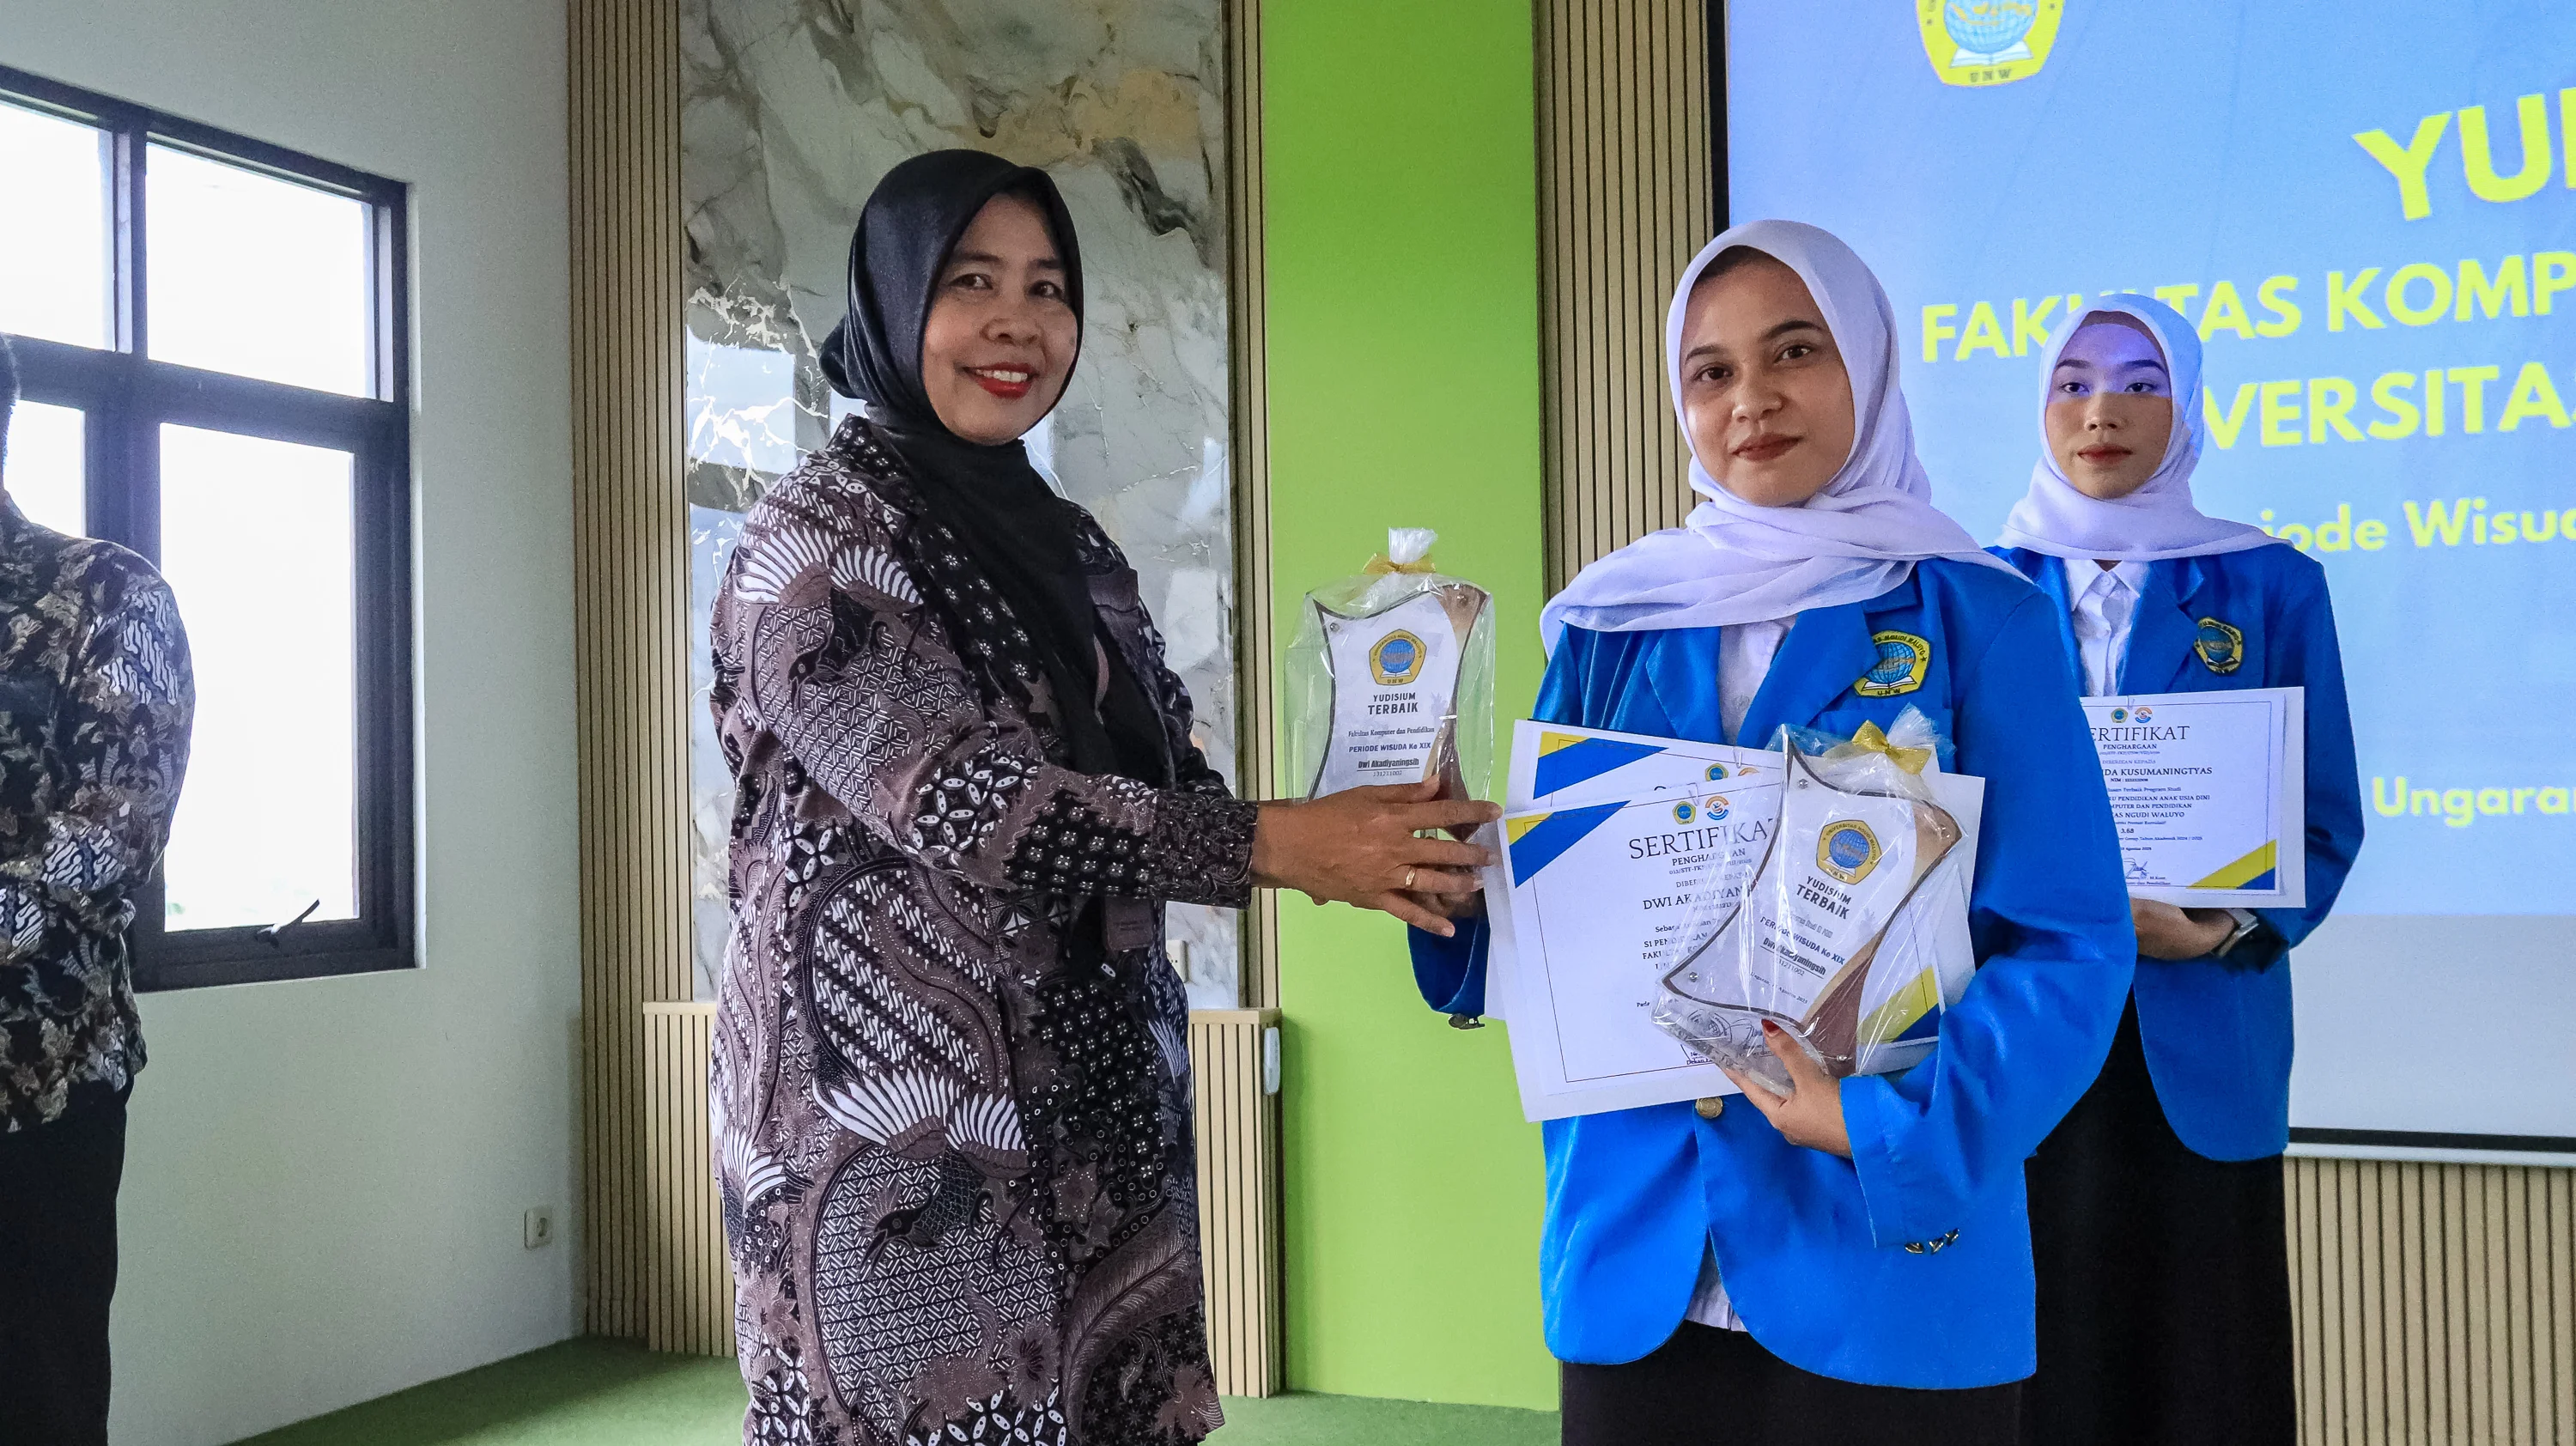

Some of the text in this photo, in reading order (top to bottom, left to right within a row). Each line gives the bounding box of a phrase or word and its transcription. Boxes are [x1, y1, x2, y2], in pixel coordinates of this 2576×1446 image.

[2351, 87, 2576, 222] YU
[1922, 251, 2576, 362] FAKTAS KOMP
[2203, 362, 2576, 450] VERSITA
[1368, 702, 1419, 715] TERBAIK
[1373, 692, 1416, 702] YUDISIUM
[2121, 767, 2213, 775] KUSUMANINGTYAS
[2372, 776, 2576, 827] Ungara
[1629, 818, 1774, 860] SERTIFIKA
[1643, 896, 1673, 910] DWI
[1796, 884, 1850, 920] TERBAIK
[1777, 944, 1826, 975] Akayaningsih
[1793, 933, 1820, 952] WISUDA
[1832, 953, 1846, 965] XIX
